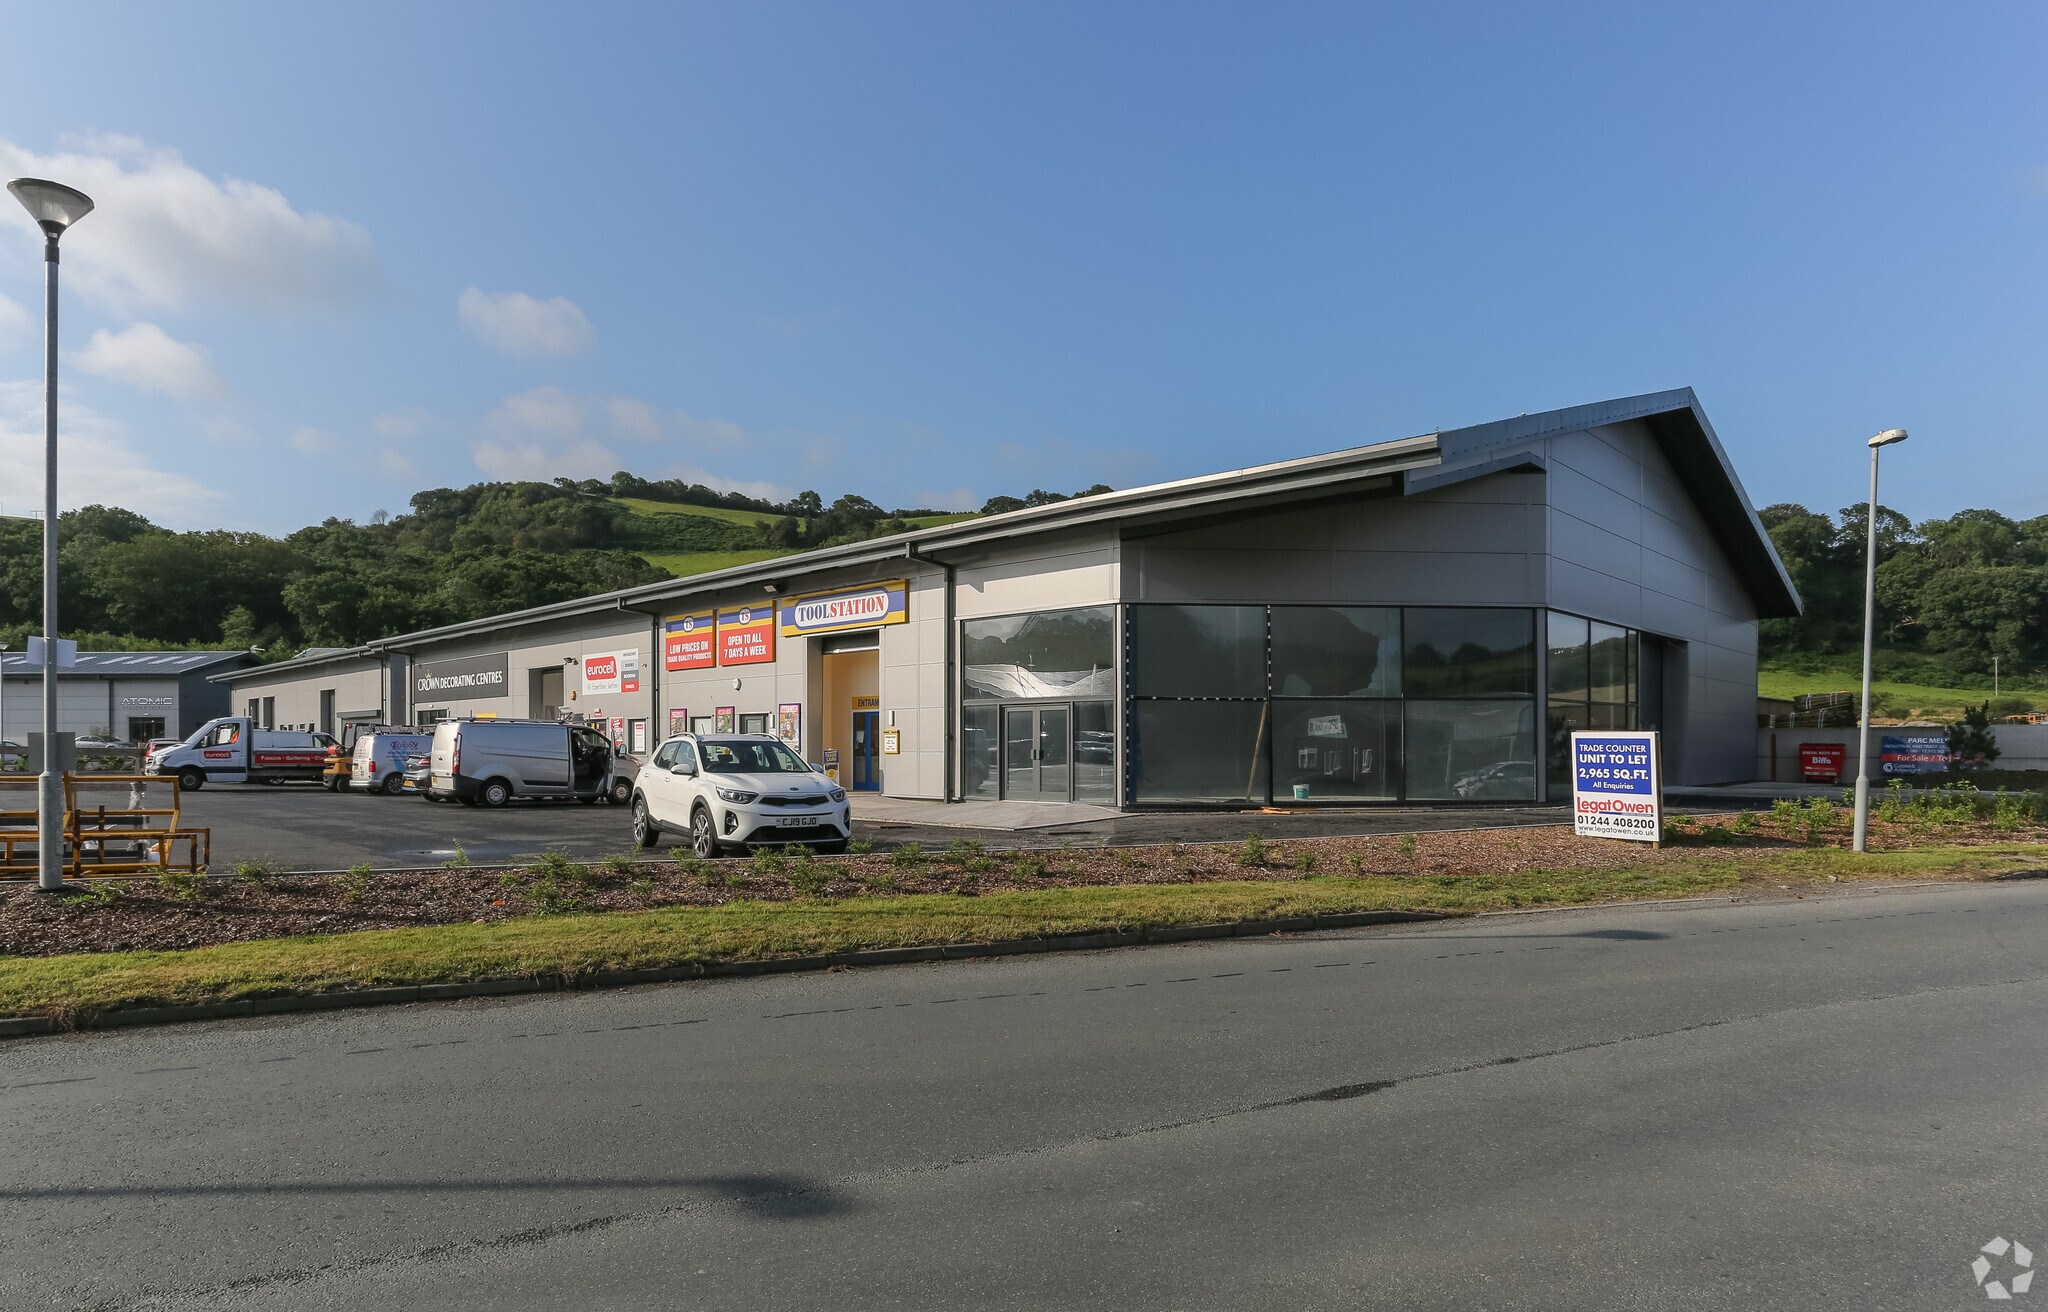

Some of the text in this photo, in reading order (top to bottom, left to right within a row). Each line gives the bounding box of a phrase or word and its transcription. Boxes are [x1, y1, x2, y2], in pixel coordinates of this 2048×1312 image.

[799, 595, 885, 622] TOOLSTATION
[727, 632, 763, 646] OPEN TO ALL
[670, 640, 709, 654] LOW PRICES ON
[724, 644, 767, 659] 7 DAYS A WEEK
[677, 654, 693, 662] QUALITY
[692, 652, 712, 660] PRODUCTS
[587, 660, 616, 676] eurocell
[418, 670, 503, 691] CROWN DECORATING CENTRES
[121, 697, 173, 705] ATOMIC
[1579, 744, 1647, 753] TRADE COUNTER
[1580, 754, 1648, 764] UNIT TO LET
[1812, 756, 1832, 764] Biffa
[1897, 754, 1910, 762] For
[1911, 754, 1929, 762] Sale
[1579, 768, 1649, 780] 2,965 SQ.FT.
[1603, 782, 1634, 790] Enquiries
[782, 818, 800, 826] CJ19
[1577, 815, 1655, 829] 01244 408200
[1578, 825, 1654, 836] www.legatowen.co.uk
